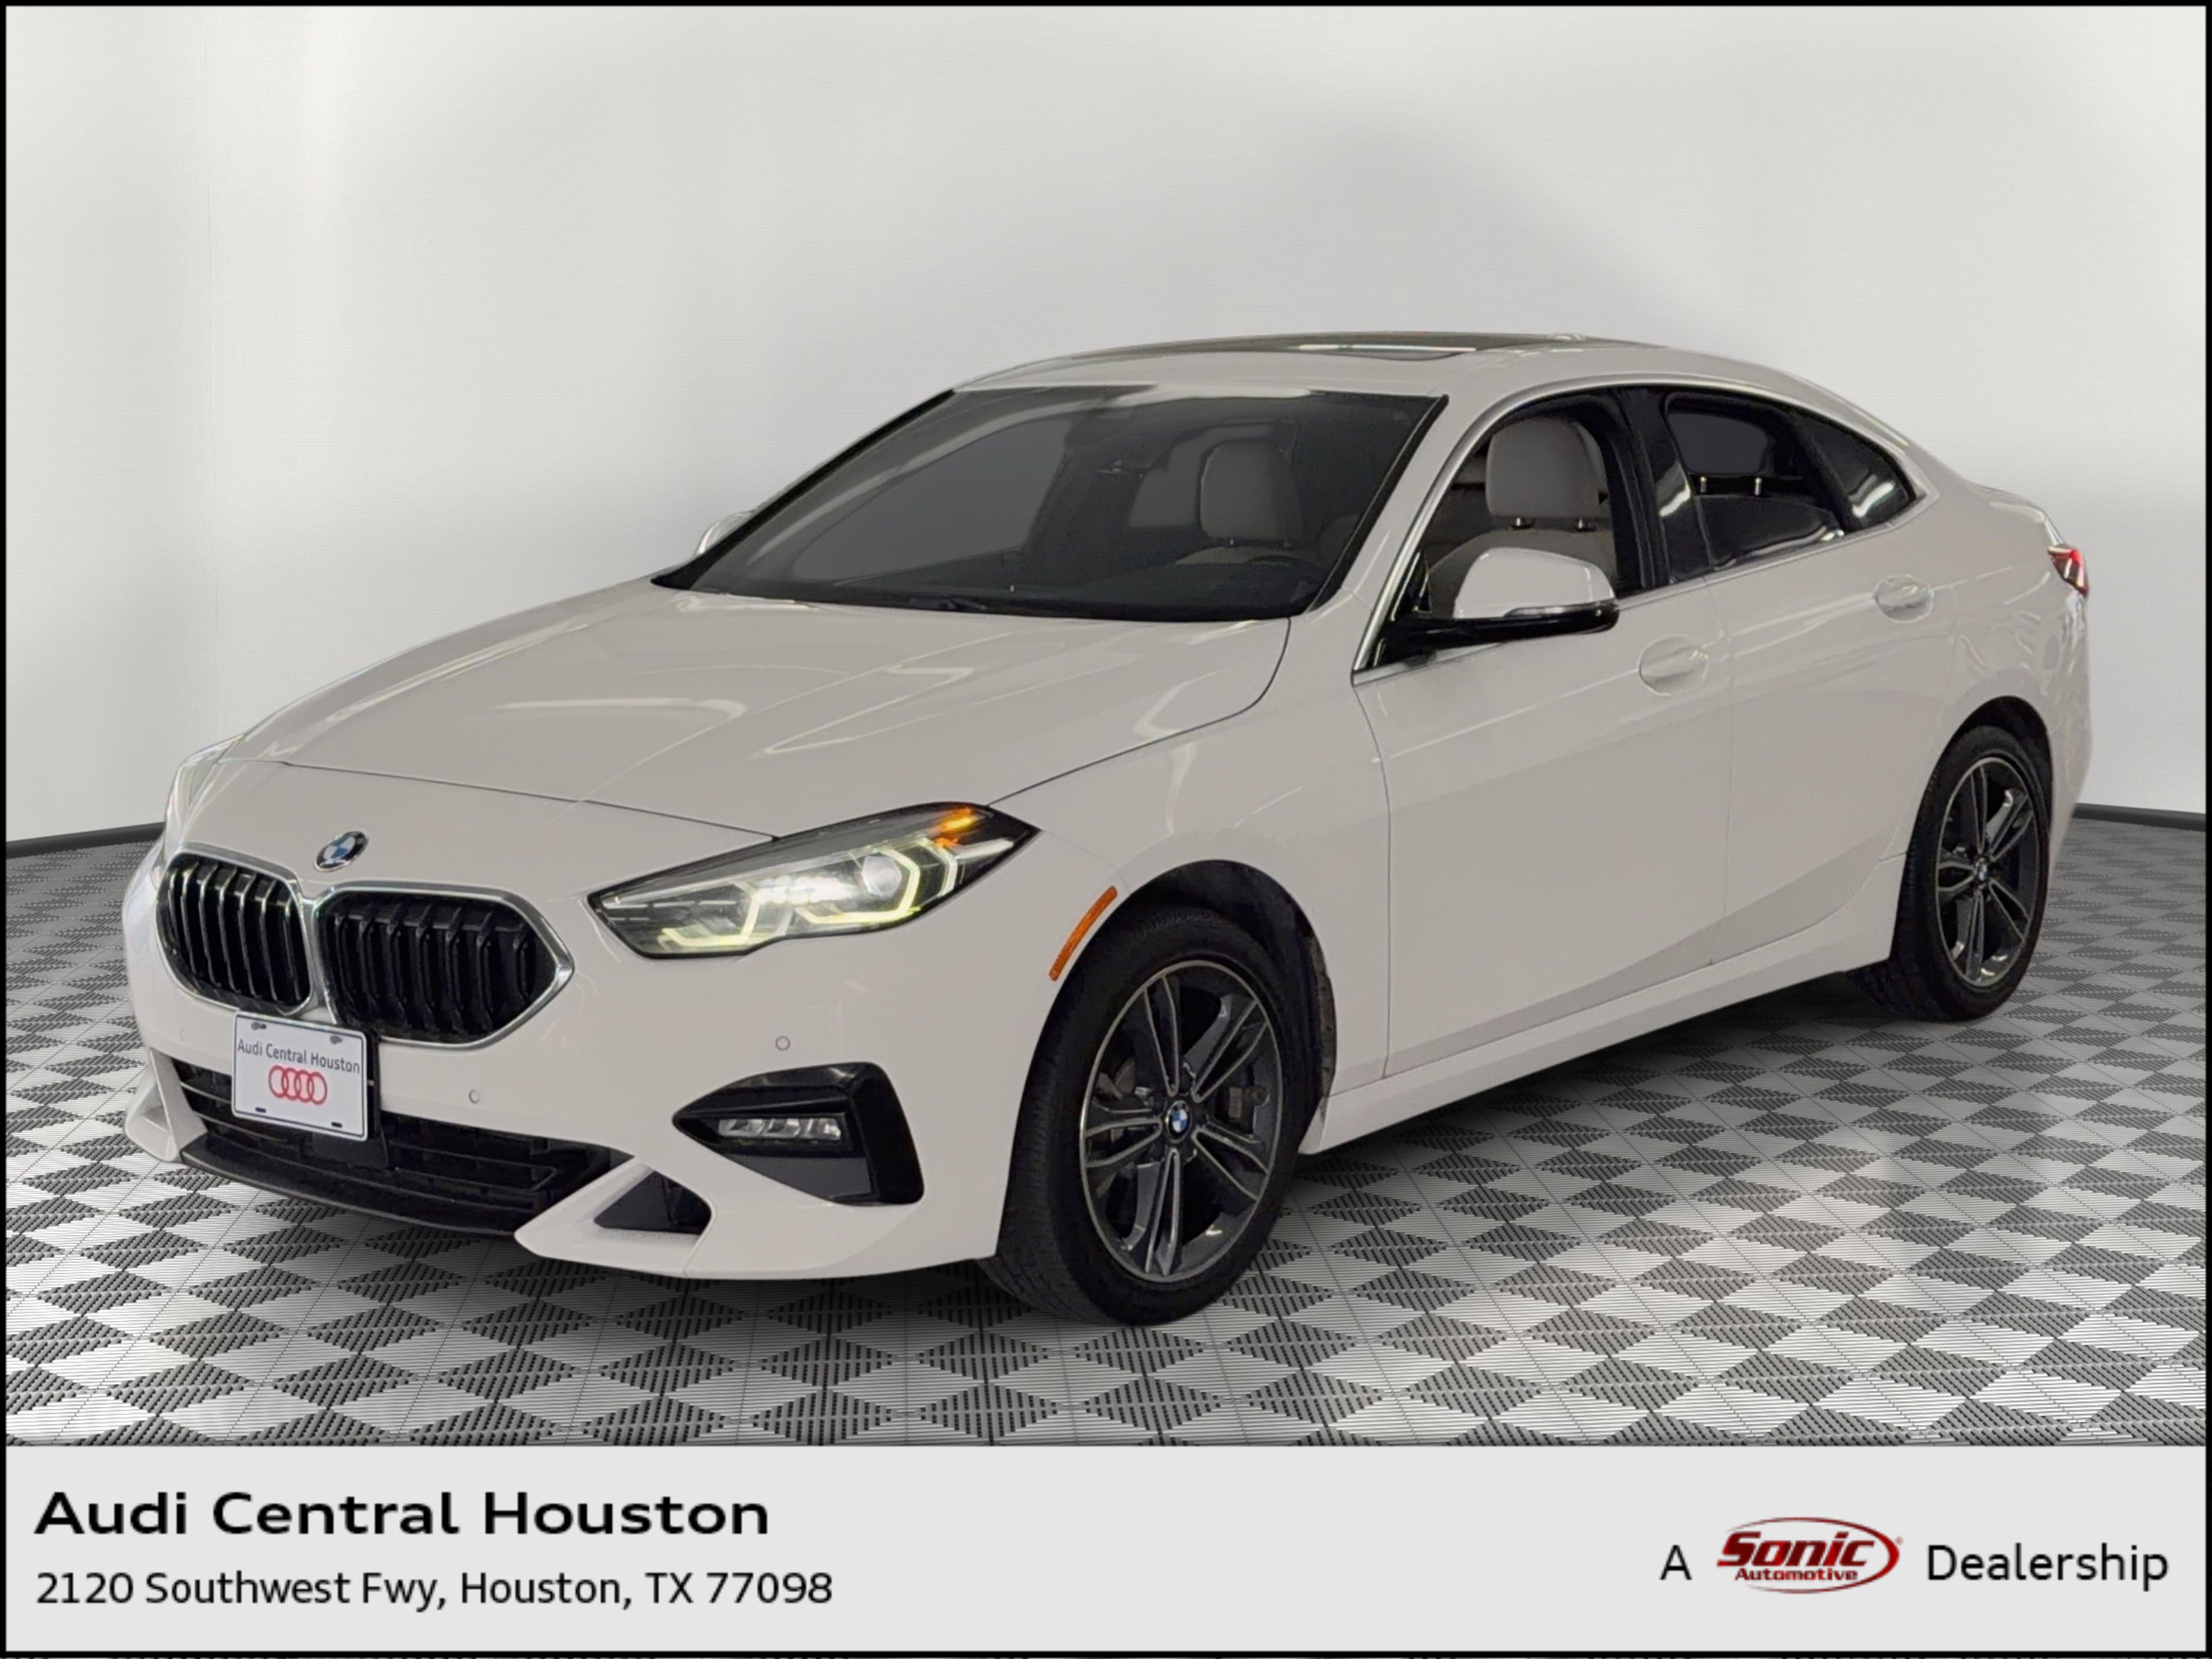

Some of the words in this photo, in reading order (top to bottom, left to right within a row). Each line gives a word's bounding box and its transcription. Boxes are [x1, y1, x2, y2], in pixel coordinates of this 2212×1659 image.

[237, 1038, 263, 1056] Audi
[265, 1042, 307, 1064] Central
[310, 1051, 360, 1074] Houston
